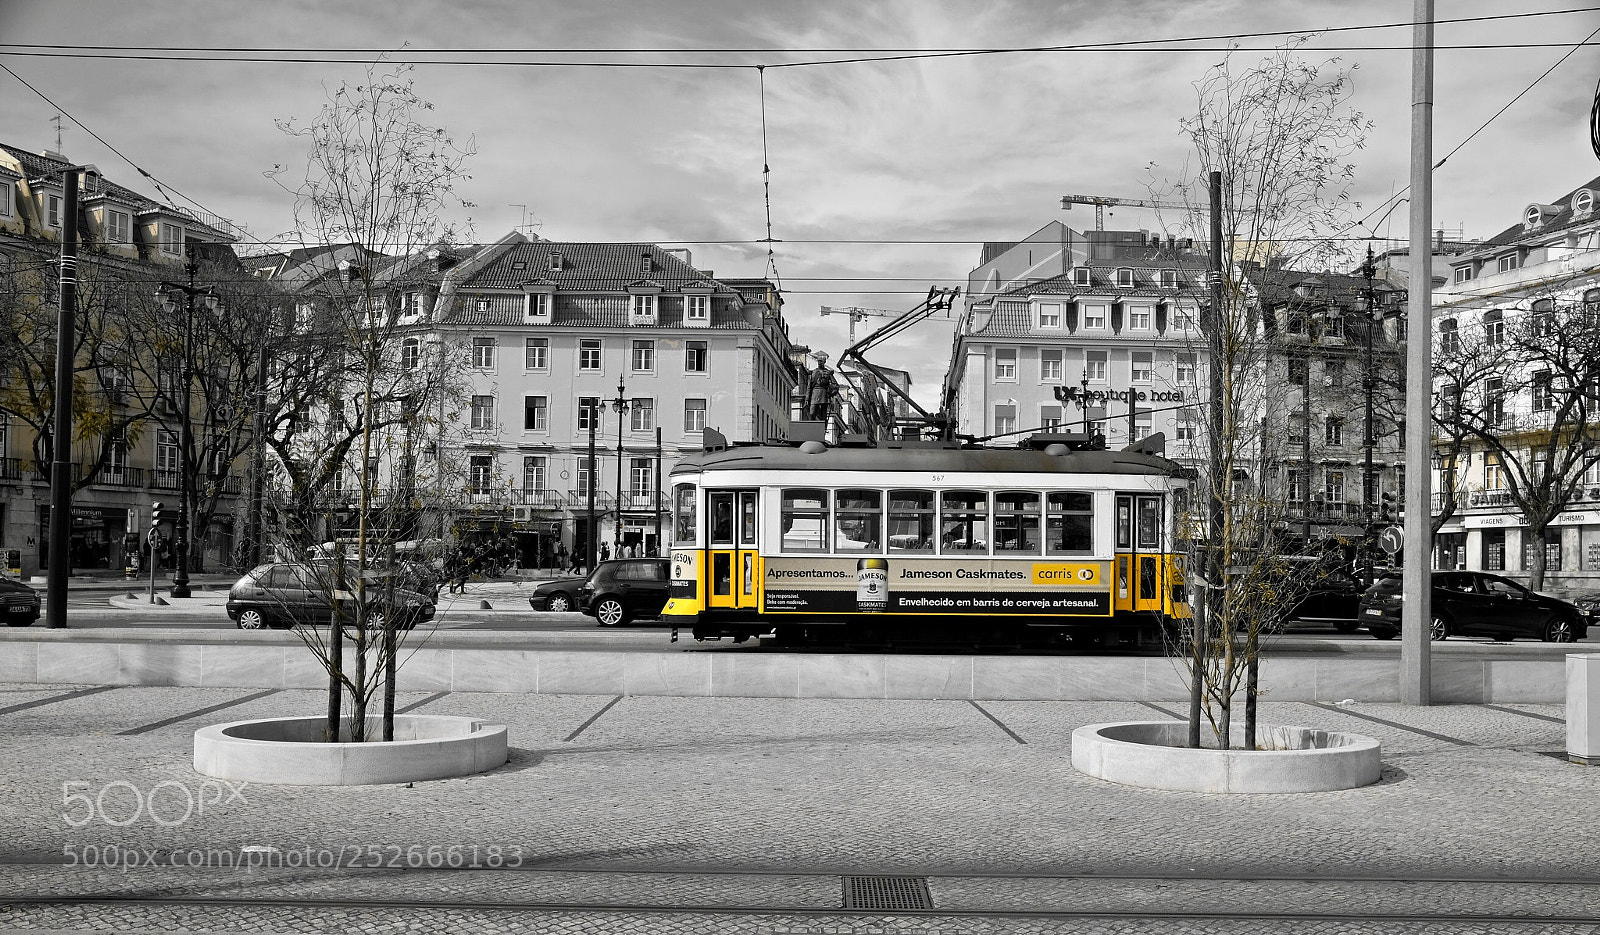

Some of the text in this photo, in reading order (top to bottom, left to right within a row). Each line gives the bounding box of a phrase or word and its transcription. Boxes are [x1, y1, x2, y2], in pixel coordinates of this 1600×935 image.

[1084, 387, 1146, 403] boutiqe
[1150, 389, 1183, 402] hotel
[1470, 492, 1517, 506] JAME
[767, 568, 854, 579] Apresentamos...
[858, 572, 888, 582] JAMESON
[900, 568, 1027, 579] Jameson Caskmates.
[1038, 568, 1072, 579] carris
[899, 597, 1099, 609] Envelhecido em barris de cerveja artesanal.
